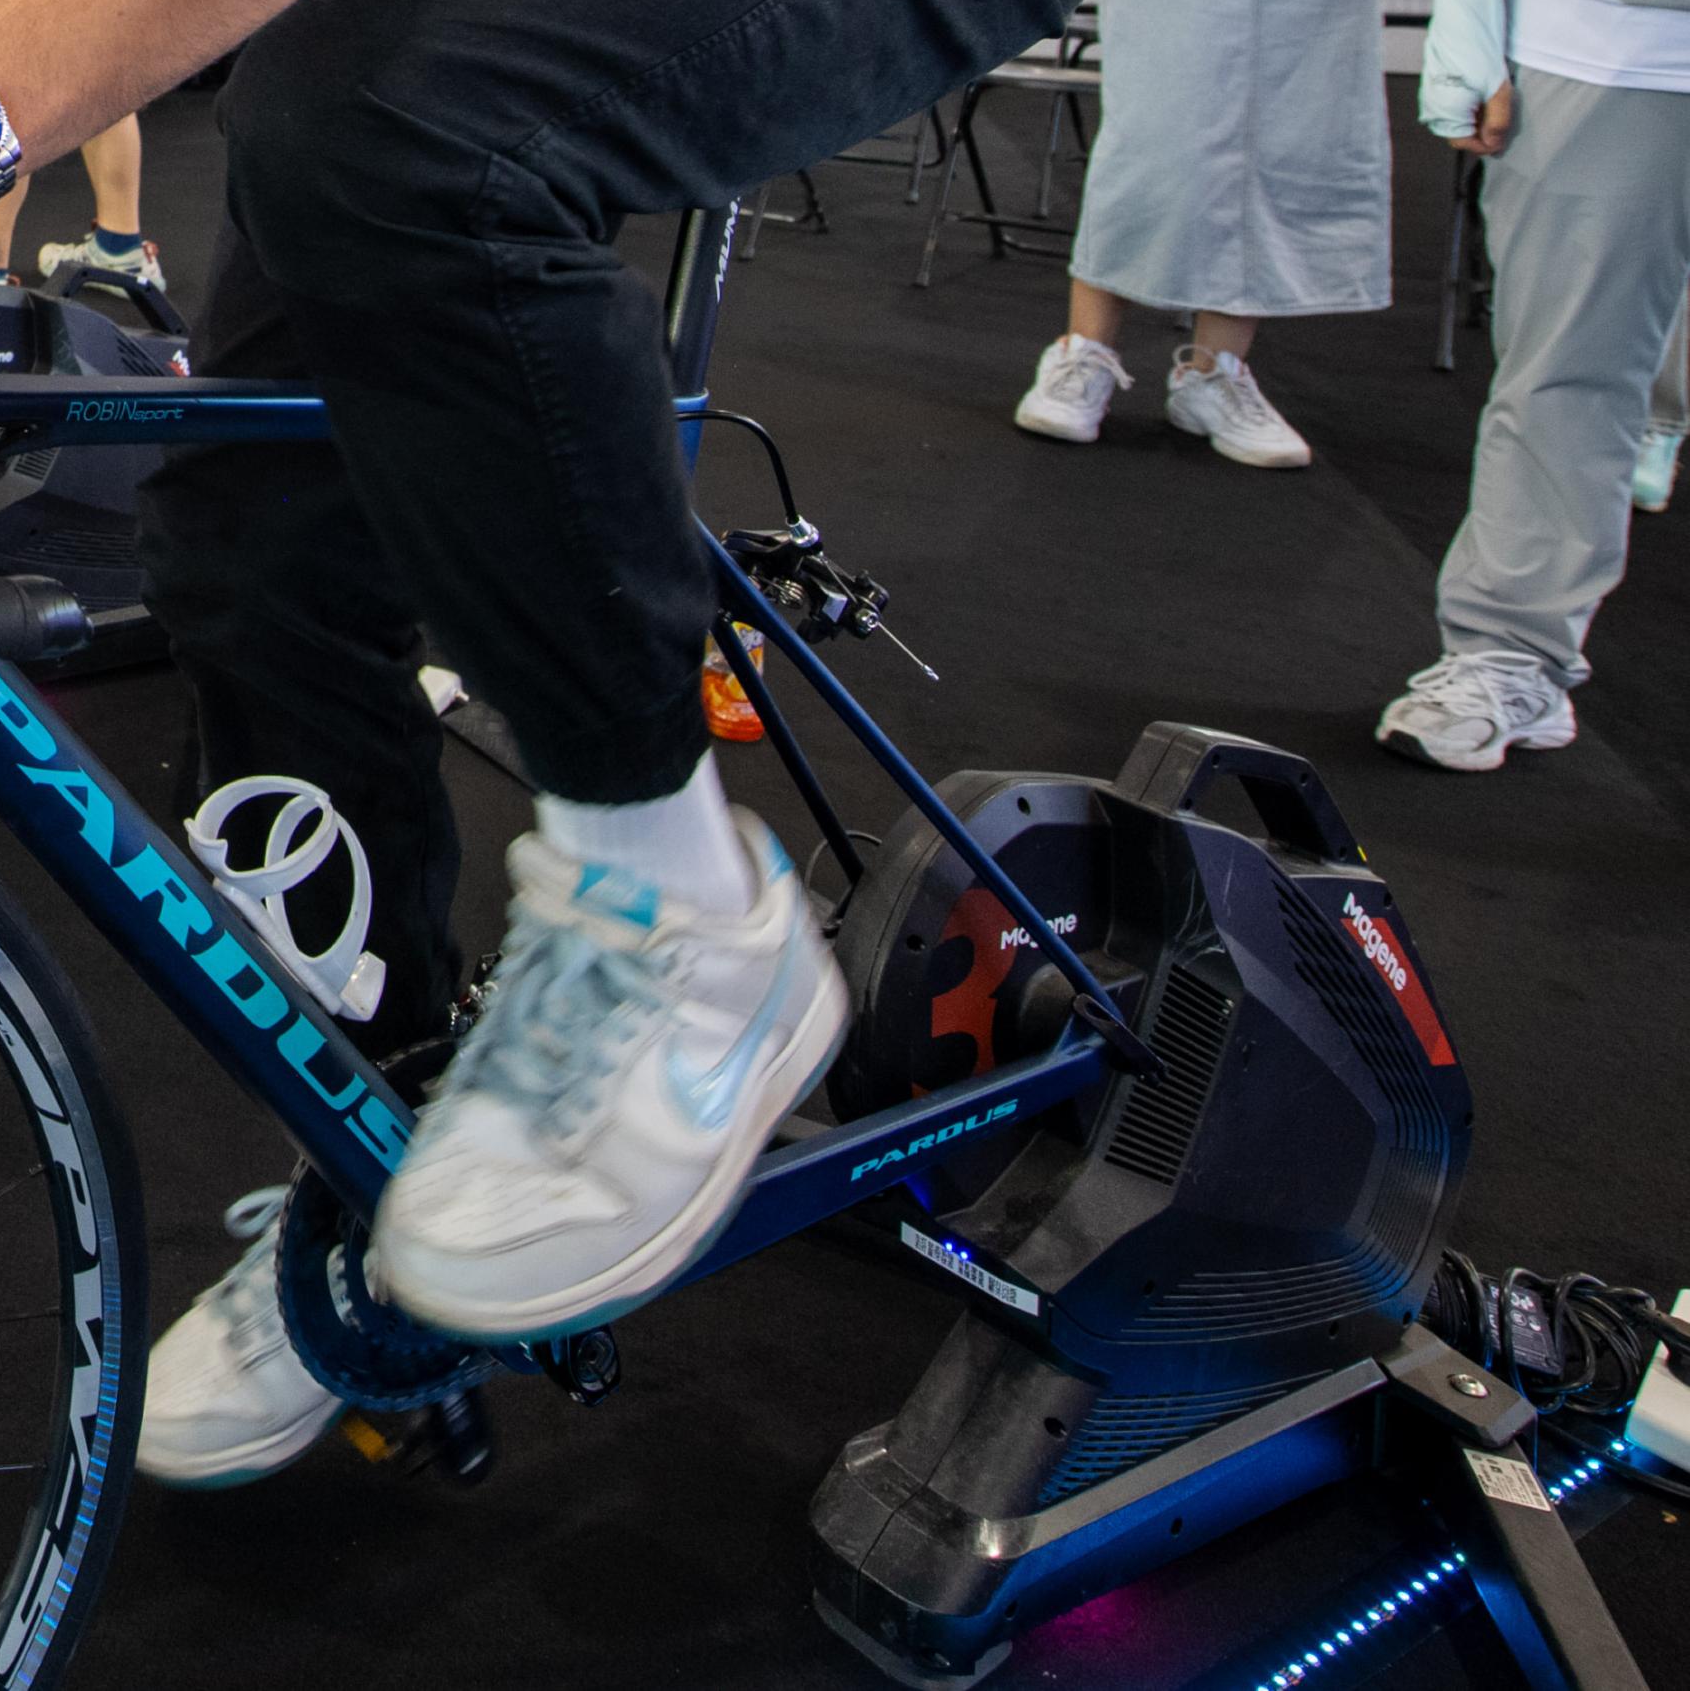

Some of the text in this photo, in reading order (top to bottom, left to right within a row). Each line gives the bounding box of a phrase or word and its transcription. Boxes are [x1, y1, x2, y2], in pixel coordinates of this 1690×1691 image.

[66, 400, 184, 422] ROBINsport
[1342, 891, 1408, 992] Magene
[850, 1098, 1019, 1182] PARDUS
